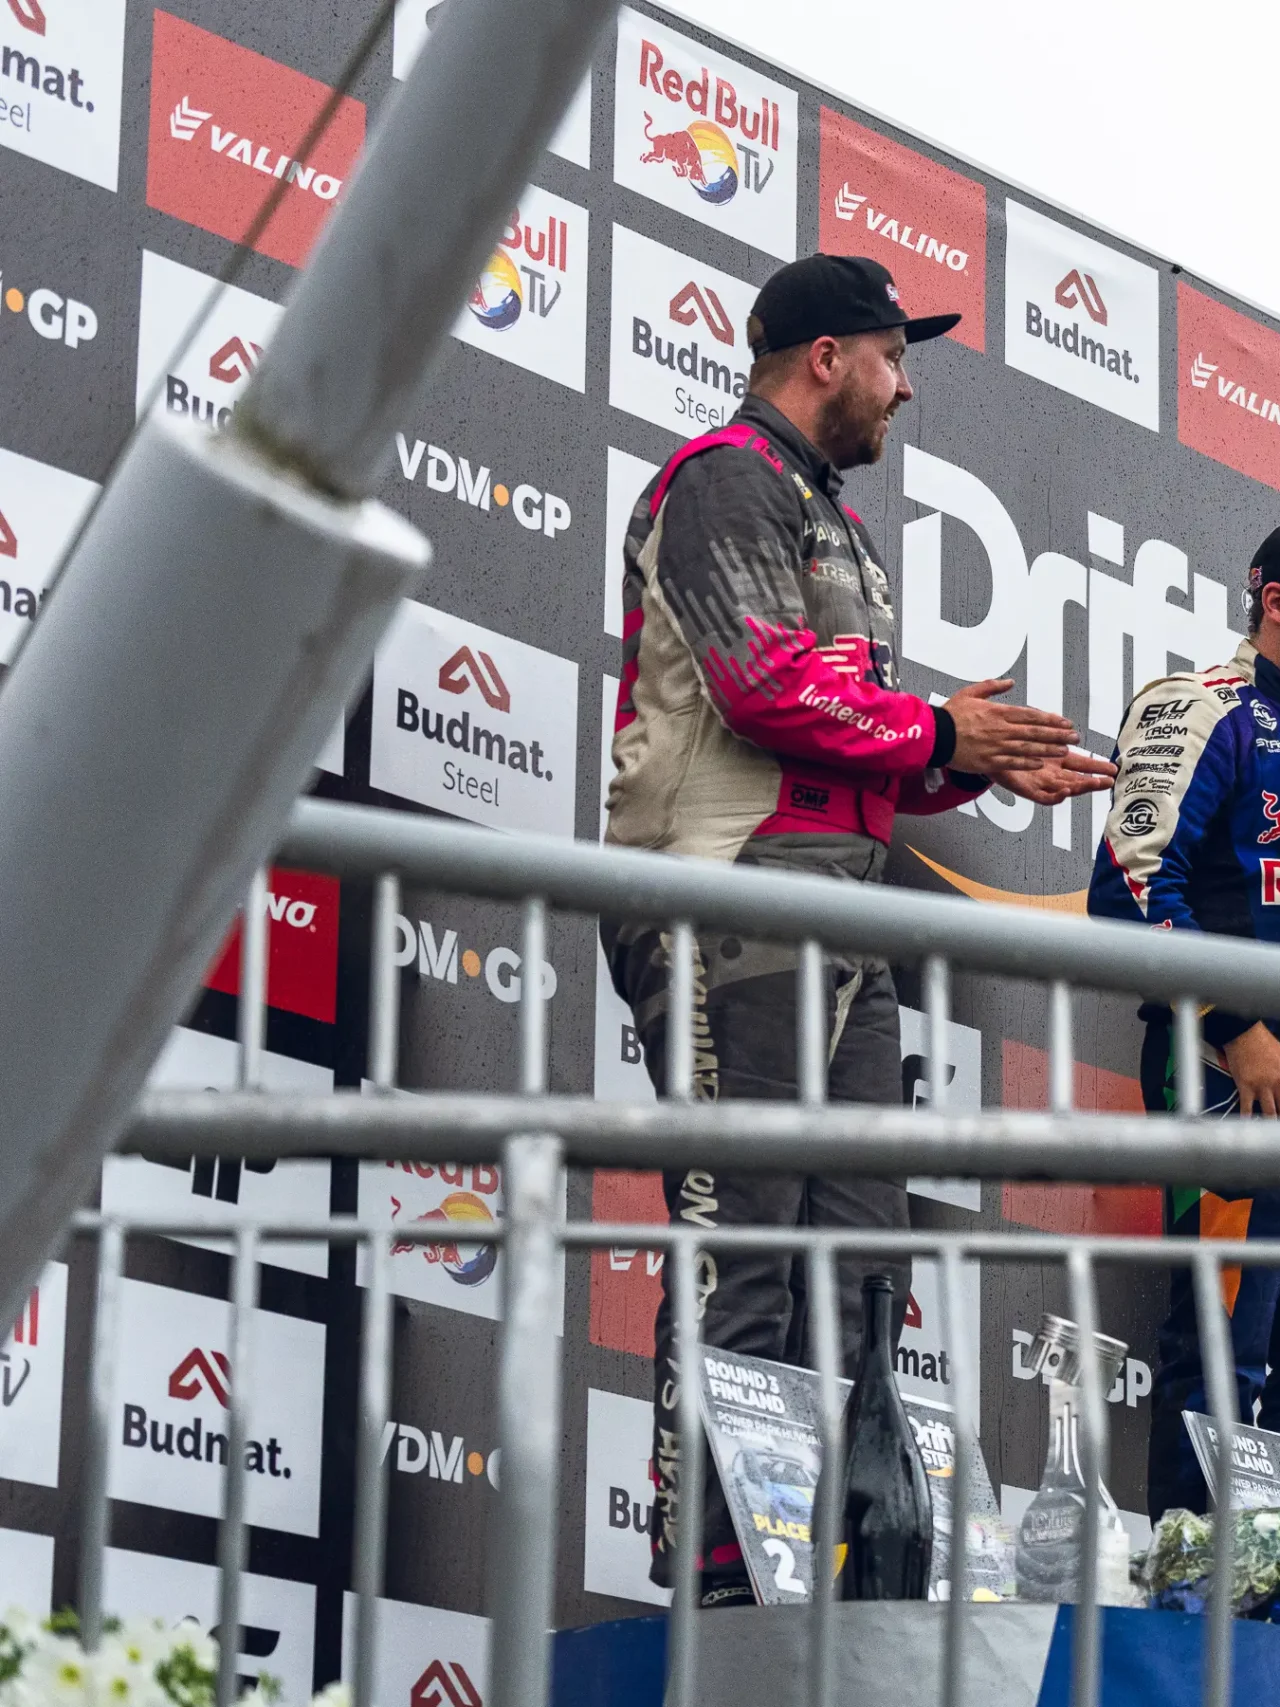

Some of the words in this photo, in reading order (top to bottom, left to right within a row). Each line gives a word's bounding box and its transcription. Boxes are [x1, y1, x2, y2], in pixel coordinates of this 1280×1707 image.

[639, 38, 708, 117] Red
[715, 77, 780, 151] Bull
[209, 124, 343, 200] VALINO
[736, 143, 774, 194] TV
[866, 207, 969, 272] VALINO
[632, 316, 748, 400] Budma
[1026, 301, 1140, 384] Budmat.
[674, 387, 725, 427] Steel
[902, 443, 1250, 742] Drift
[397, 688, 553, 781] Budmat.
[442, 761, 499, 807] Steel
[1121, 813, 1157, 826] ACL
[704, 1357, 767, 1390] ROUND
[766, 1374, 780, 1394] 3
[708, 1378, 786, 1414] FINLAND
[761, 1538, 808, 1595] 2
